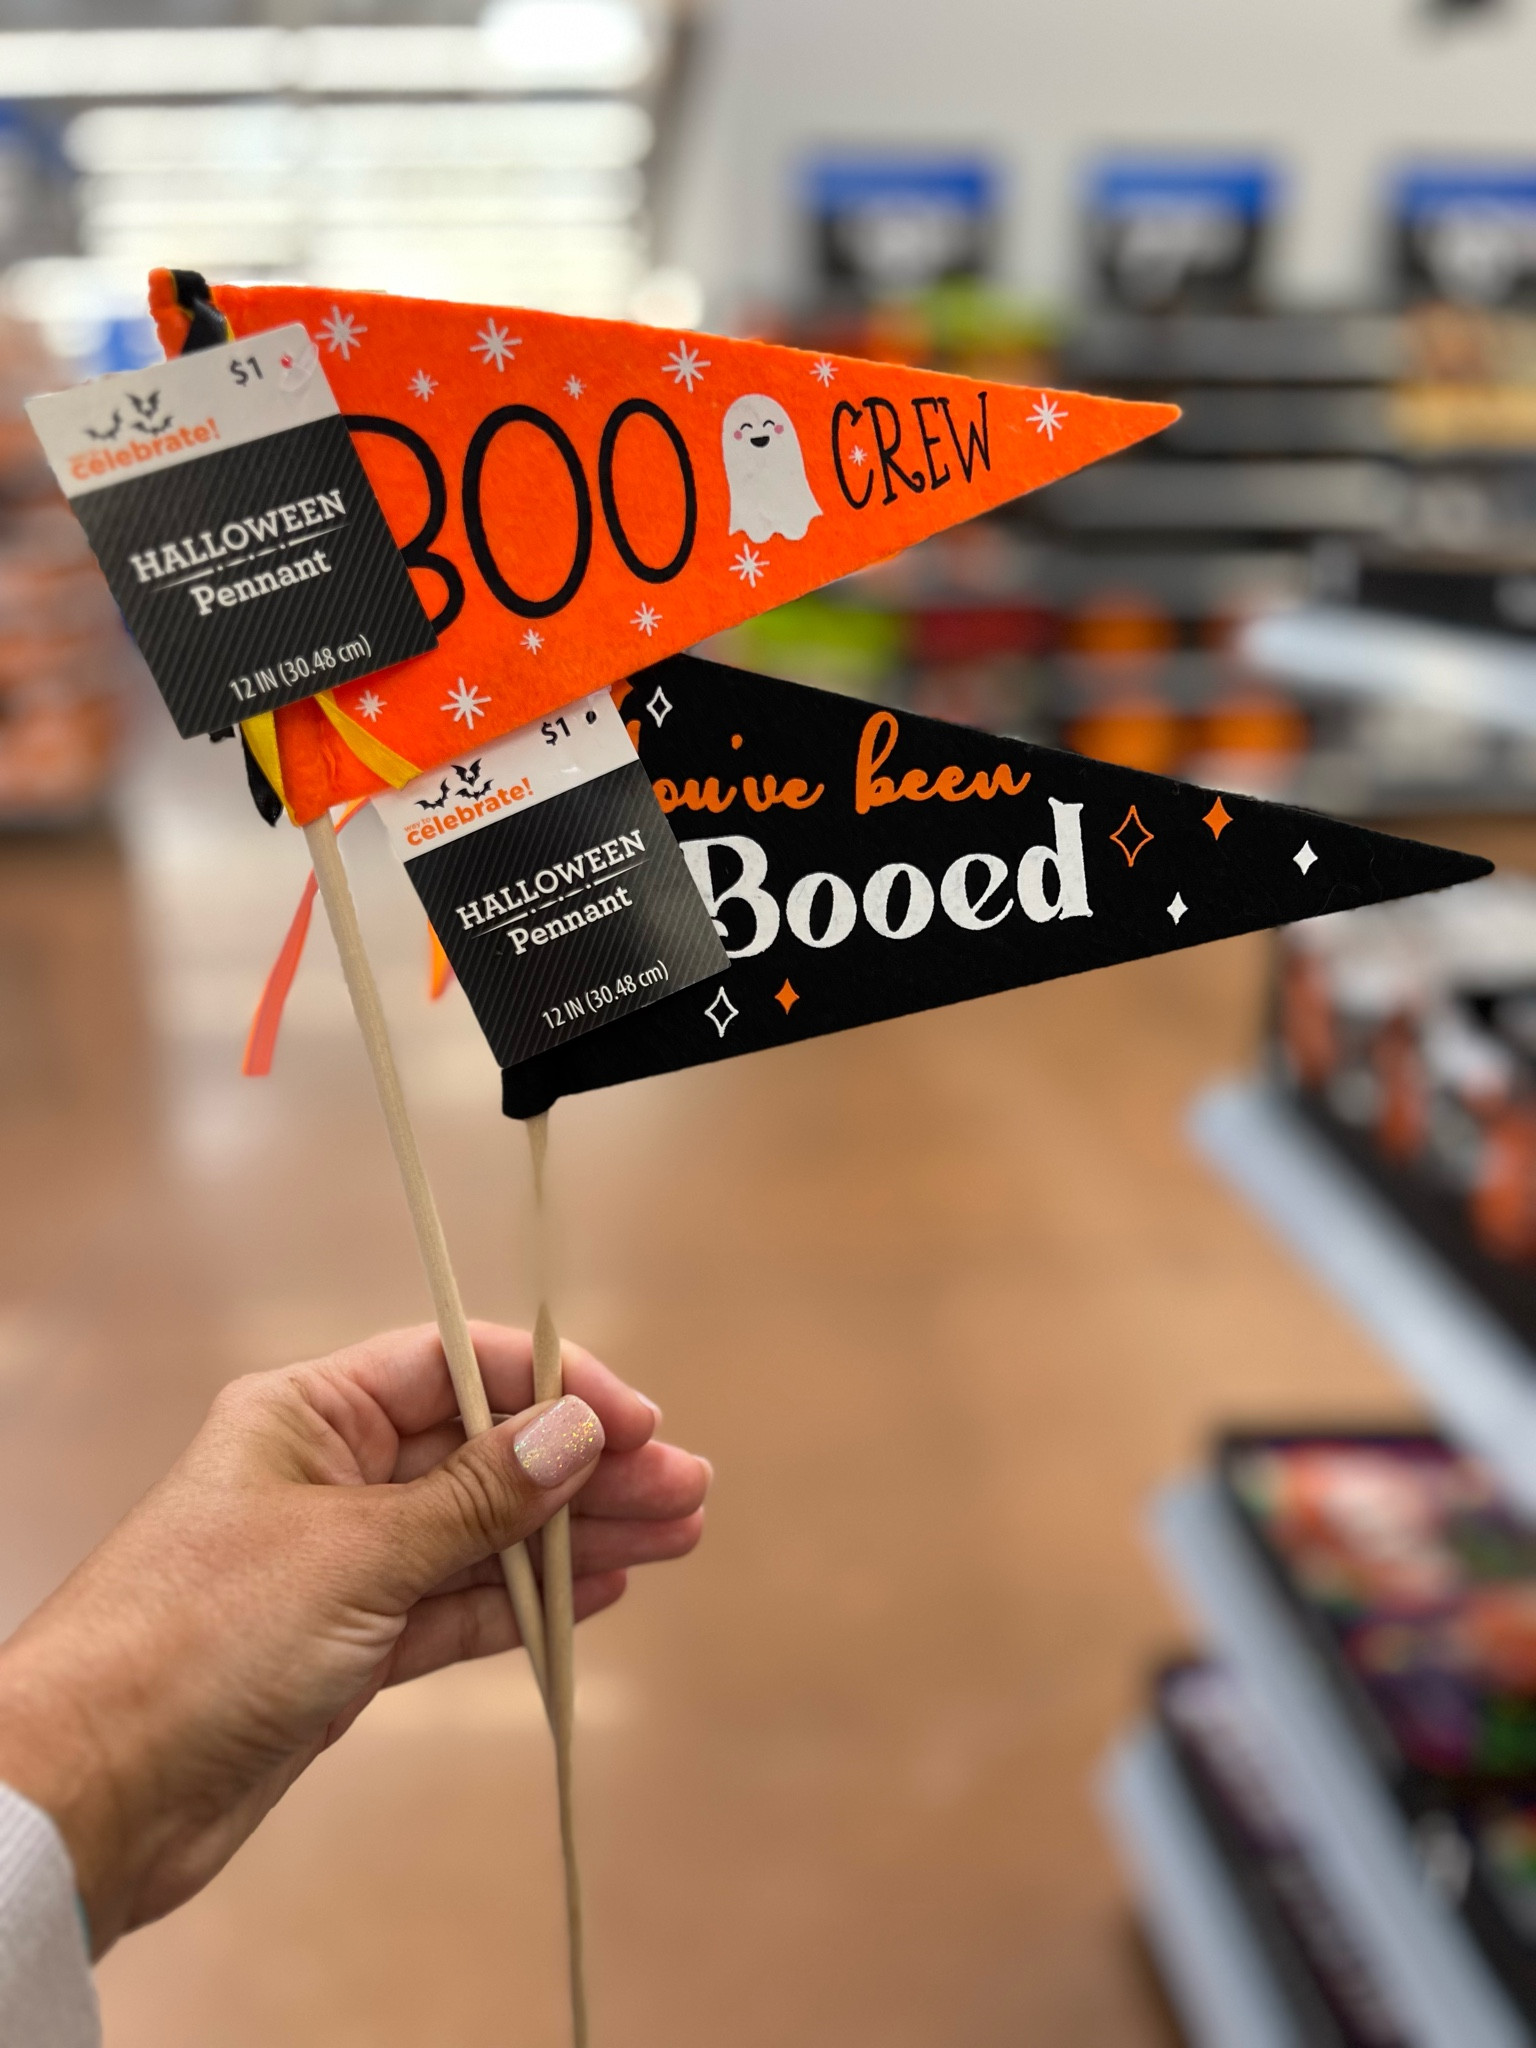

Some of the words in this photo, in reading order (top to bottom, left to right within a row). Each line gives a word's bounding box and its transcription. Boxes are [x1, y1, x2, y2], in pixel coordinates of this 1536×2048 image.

[229, 356, 263, 386] $1
[71, 417, 220, 480] celebrate!
[130, 489, 347, 583] HALLOWEEN
[343, 397, 697, 637] BOO
[831, 391, 991, 510] CREW
[190, 549, 332, 617] Pennant
[230, 676, 257, 702] 12
[256, 668, 279, 693] IN
[279, 648, 337, 687] (30.48
[338, 634, 373, 662] cm)
[541, 717, 571, 746] $1
[627, 719, 825, 814] ou've
[856, 711, 1031, 815] been
[406, 777, 534, 847] celebrate!
[455, 828, 646, 931] HALLOWEEN
[679, 796, 1094, 960] Booed
[506, 885, 633, 956] Pennant
[542, 1008, 565, 1030] 12
[562, 1001, 587, 1023] IN
[587, 977, 638, 1015] (30.48
[637, 959, 671, 989] cm)
